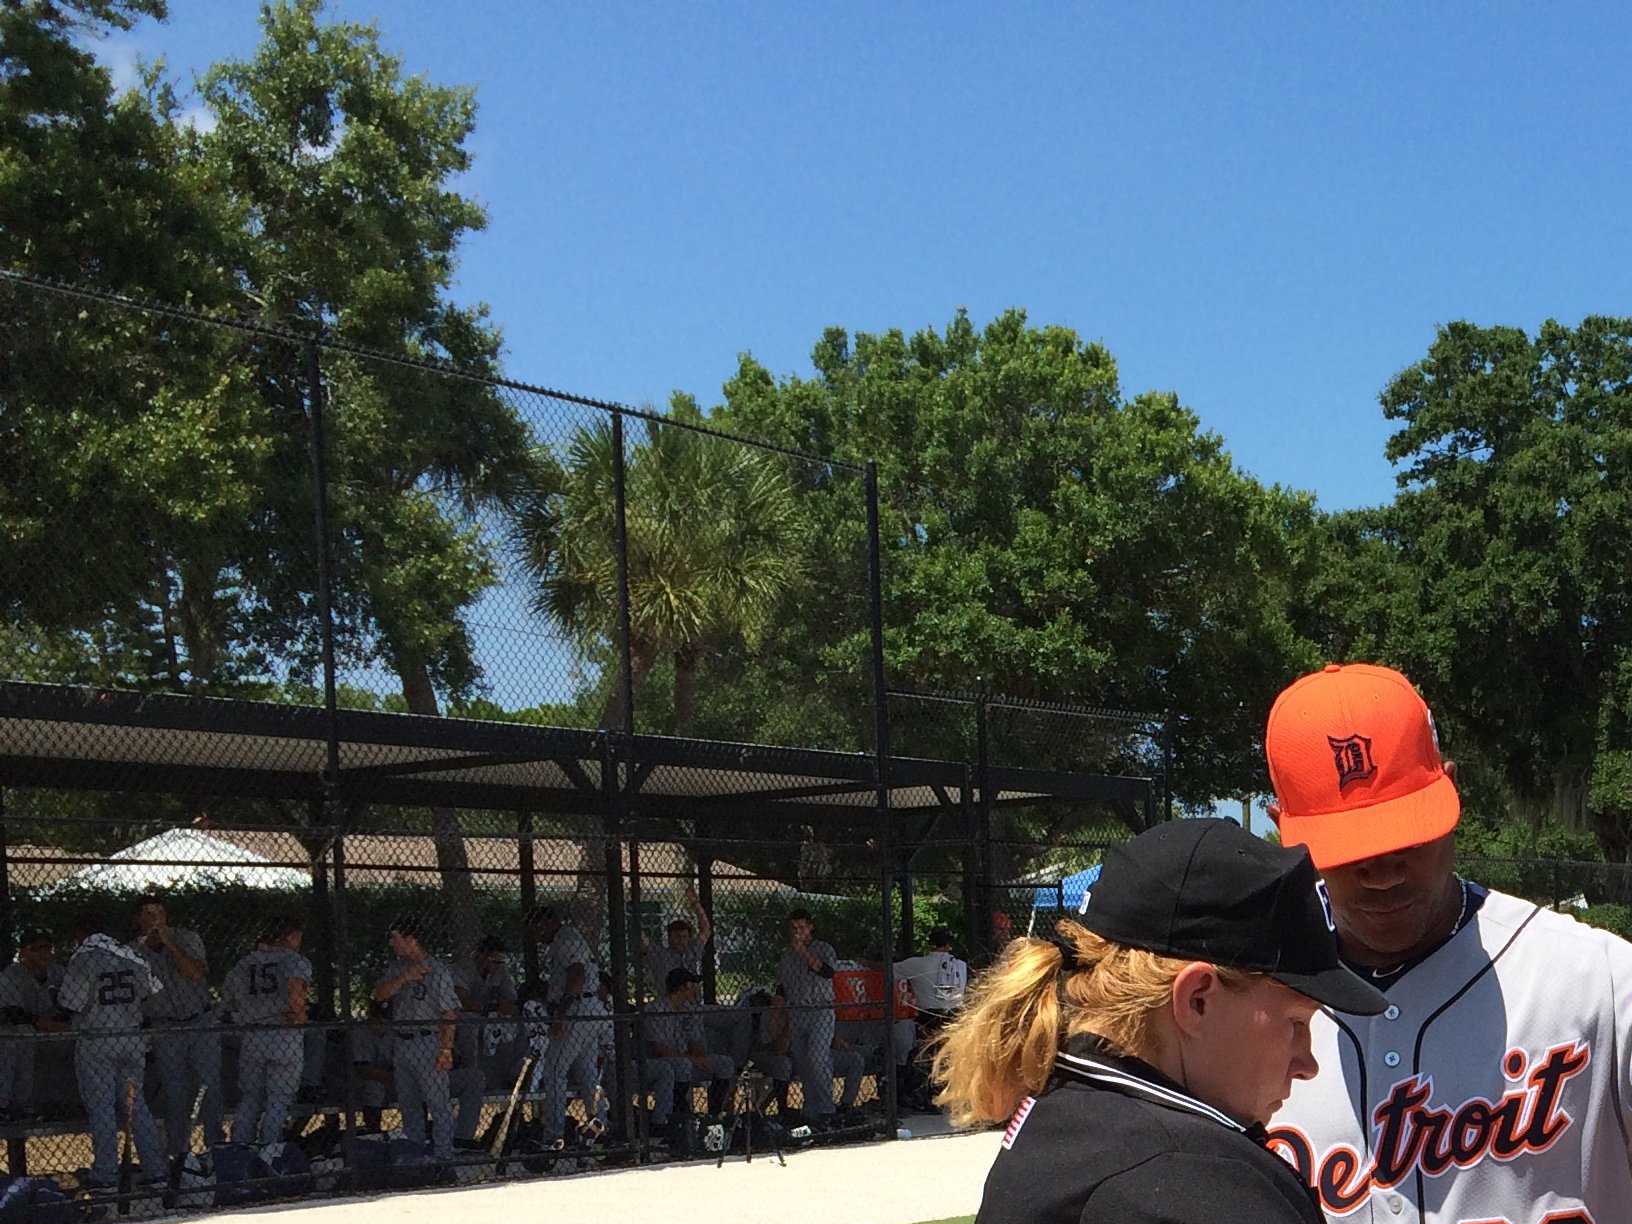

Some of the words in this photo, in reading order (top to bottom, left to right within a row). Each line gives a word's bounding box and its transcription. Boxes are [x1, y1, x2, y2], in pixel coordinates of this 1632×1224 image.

[1327, 733, 1378, 791] D
[99, 970, 136, 1006] 25
[249, 962, 279, 995] 15
